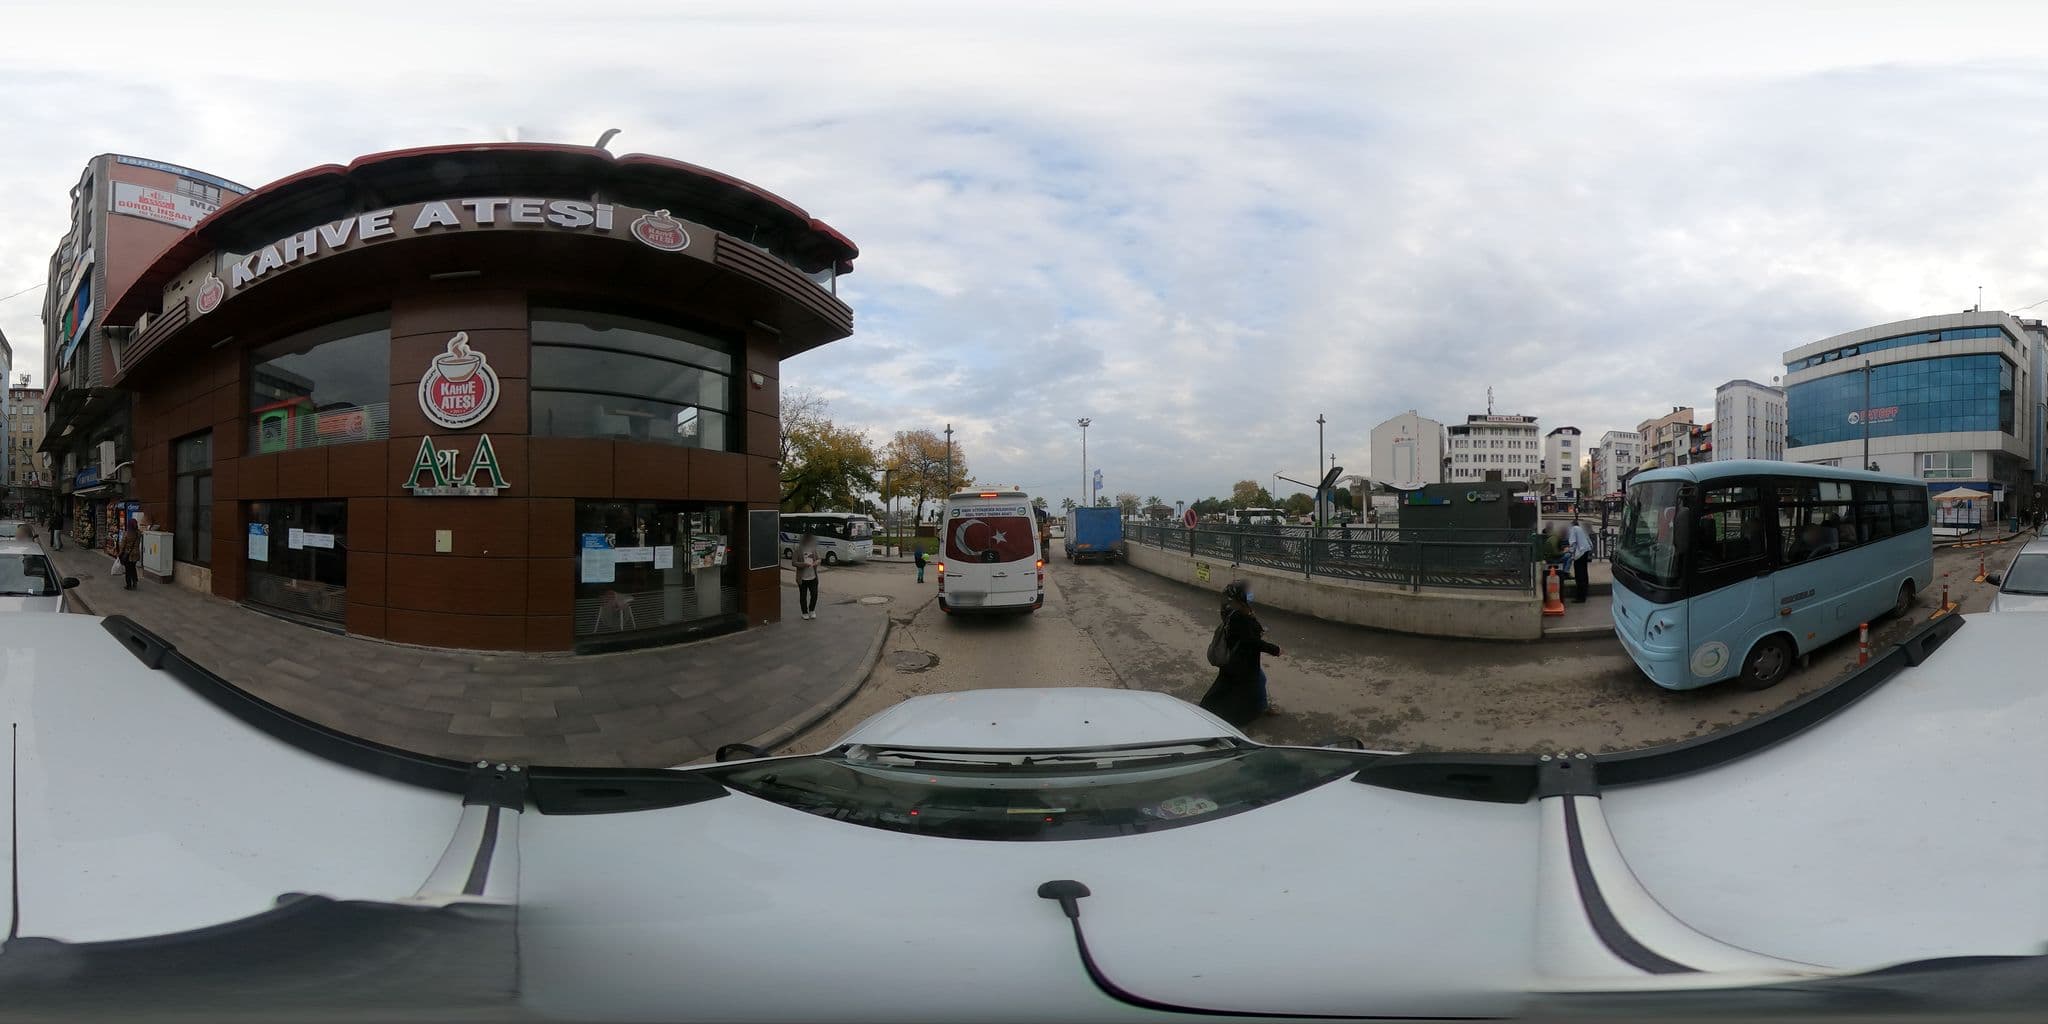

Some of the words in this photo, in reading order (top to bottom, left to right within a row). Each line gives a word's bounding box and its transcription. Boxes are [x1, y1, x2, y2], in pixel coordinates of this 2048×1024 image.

[232, 210, 394, 288] KAHVE
[413, 198, 614, 231] ATEŞİ
[440, 381, 476, 396] KAHVE
